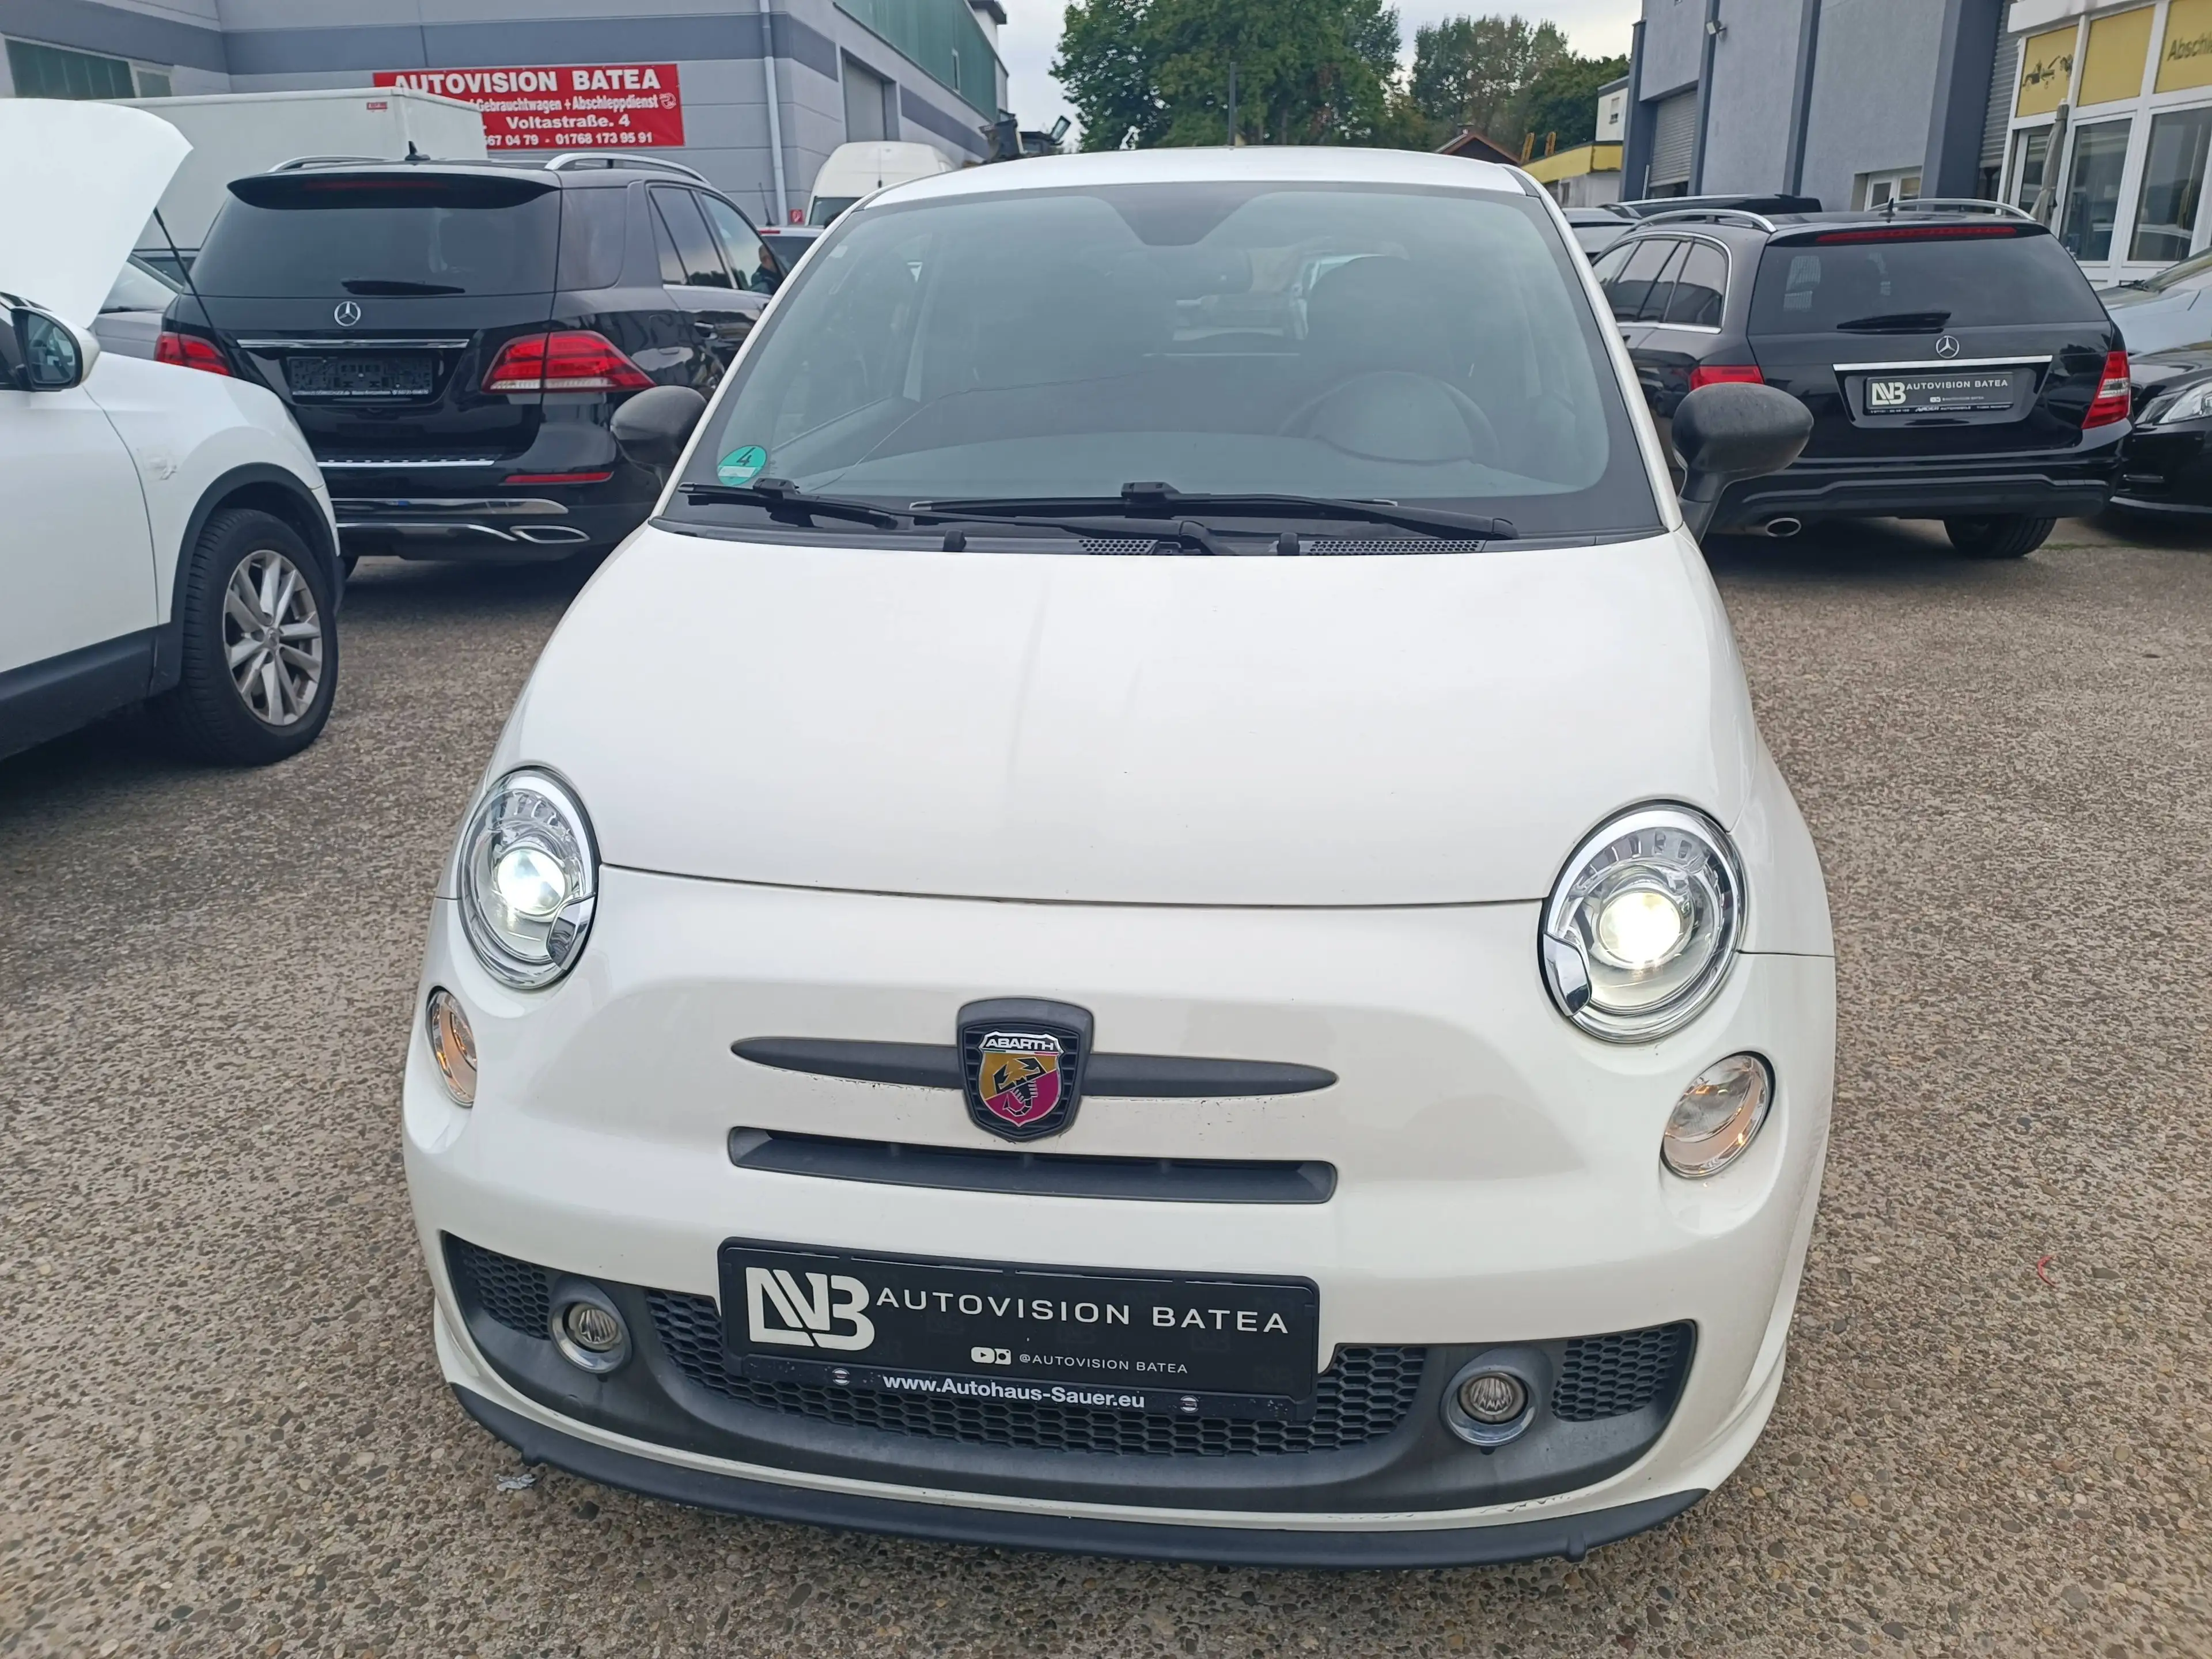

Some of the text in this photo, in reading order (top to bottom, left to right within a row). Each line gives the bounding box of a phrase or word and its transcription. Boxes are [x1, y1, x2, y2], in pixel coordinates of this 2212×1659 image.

[395, 69, 661, 94] AUTOVISION BATEA
[476, 97, 562, 114] Gebrauchtwagen
[572, 93, 658, 112] Abschleppdienst
[505, 113, 630, 130] Voltastraße. 4
[505, 134, 521, 146] 04
[523, 133, 539, 145] 79
[596, 132, 618, 144] 173
[638, 131, 653, 143] 91
[1906, 379, 2008, 391] AUTOVISION BATEA
[736, 447, 756, 466] 4
[986, 1037, 1054, 1051] ABARTH
[876, 1287, 1289, 1334] AUTOVISION BATEA
[1019, 1353, 1188, 1374] @AUTOVISION BATEA
[883, 1374, 1145, 1408] www.Autohaus-Sauer.eu
